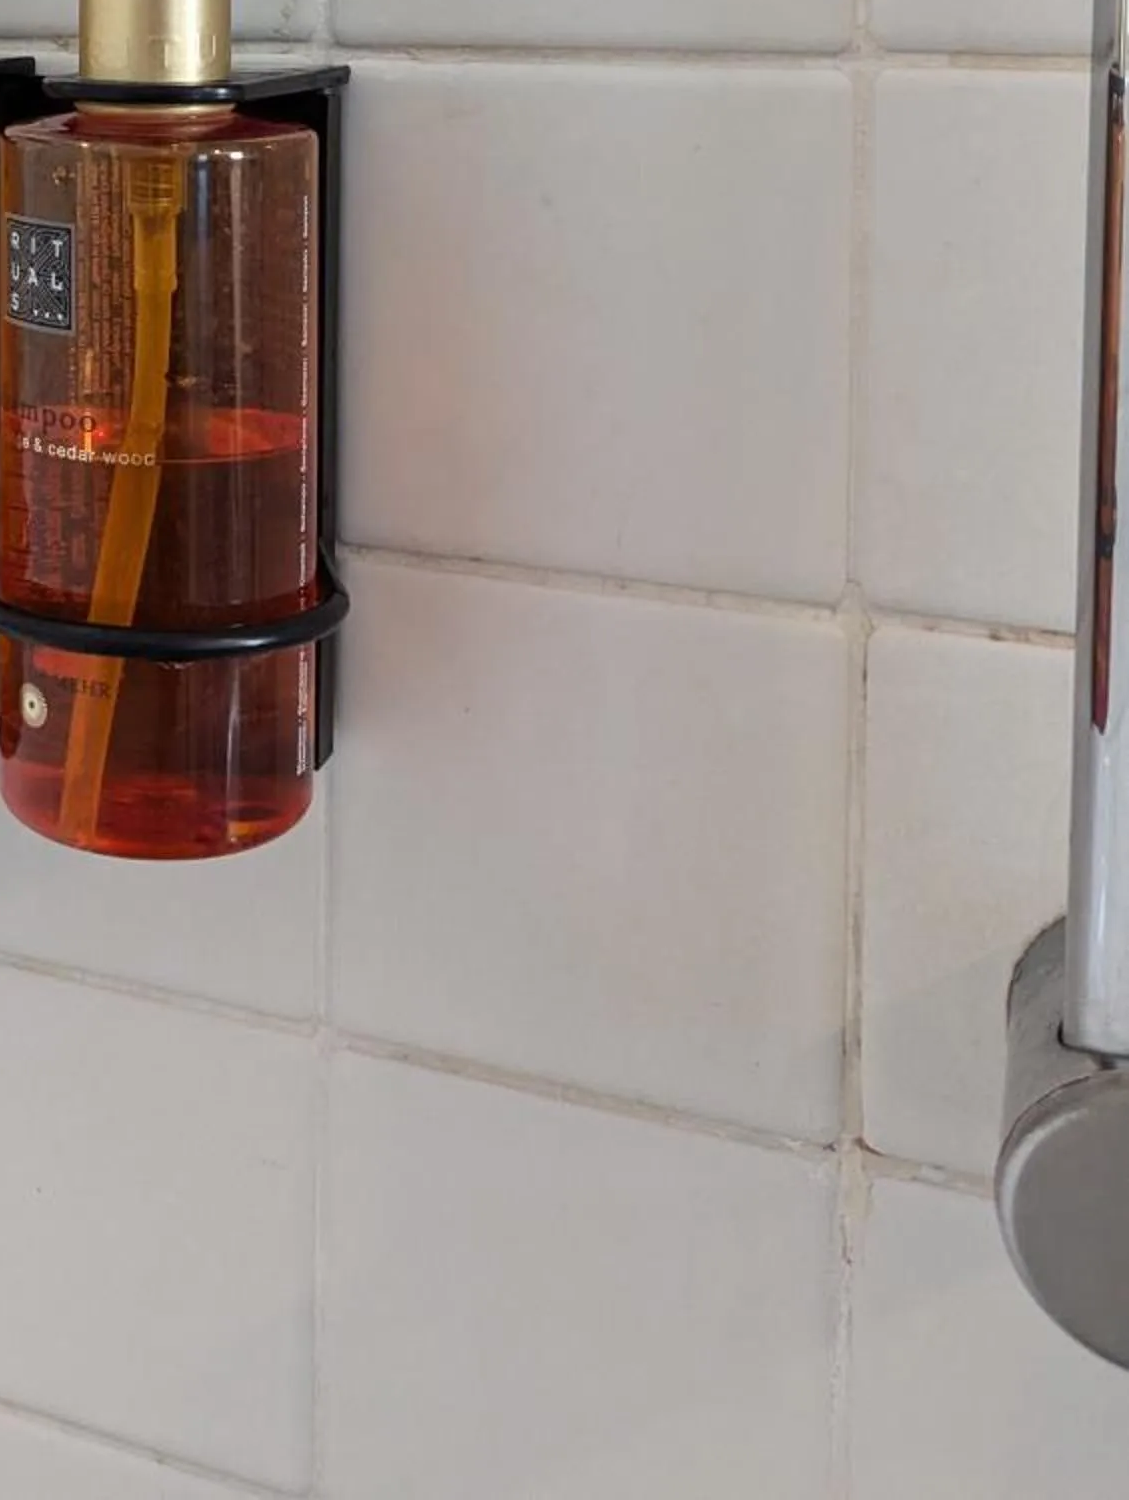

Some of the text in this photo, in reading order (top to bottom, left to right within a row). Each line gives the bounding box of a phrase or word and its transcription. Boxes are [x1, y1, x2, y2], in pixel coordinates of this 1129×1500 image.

[19, 404, 97, 436] mpoo
[34, 437, 43, 453] &
[48, 442, 95, 464] cedar
